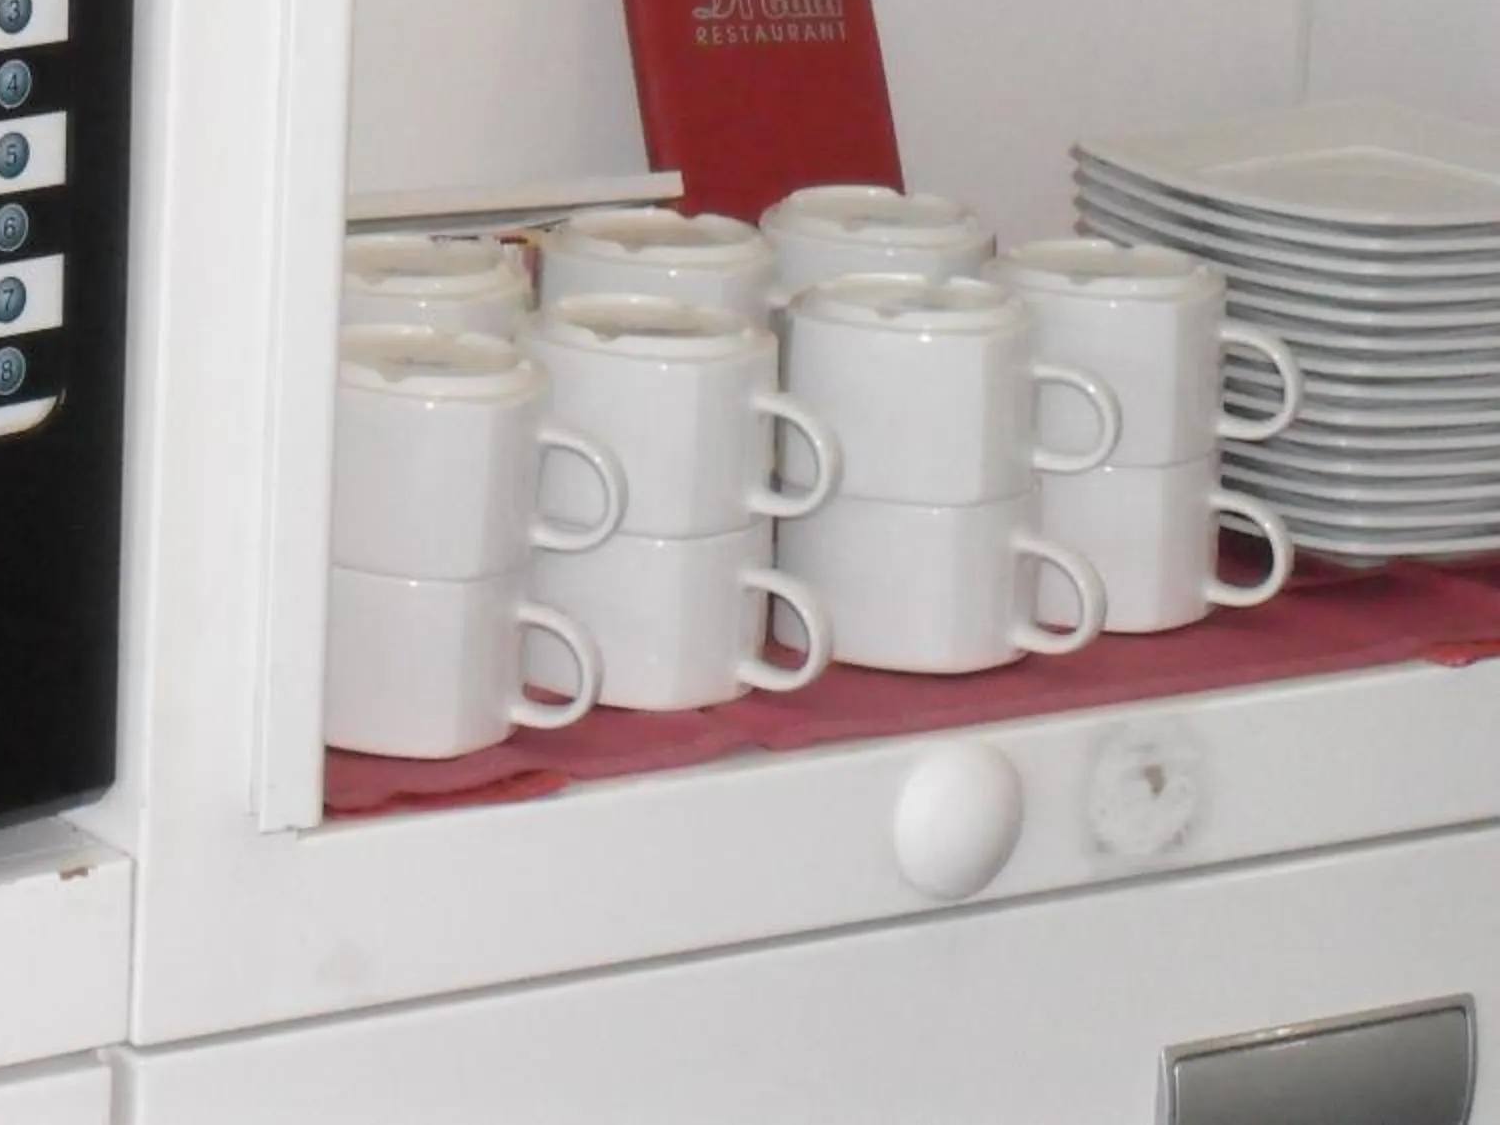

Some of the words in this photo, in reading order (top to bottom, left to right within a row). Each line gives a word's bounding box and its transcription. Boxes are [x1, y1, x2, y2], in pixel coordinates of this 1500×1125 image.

[7, 0, 21, 23] 3
[696, 21, 846, 45] RESTAURANT
[6, 74, 19, 94] 4
[5, 142, 18, 166] 5
[3, 216, 16, 239] 6
[2, 288, 15, 313] 7
[1, 360, 14, 383] 8
